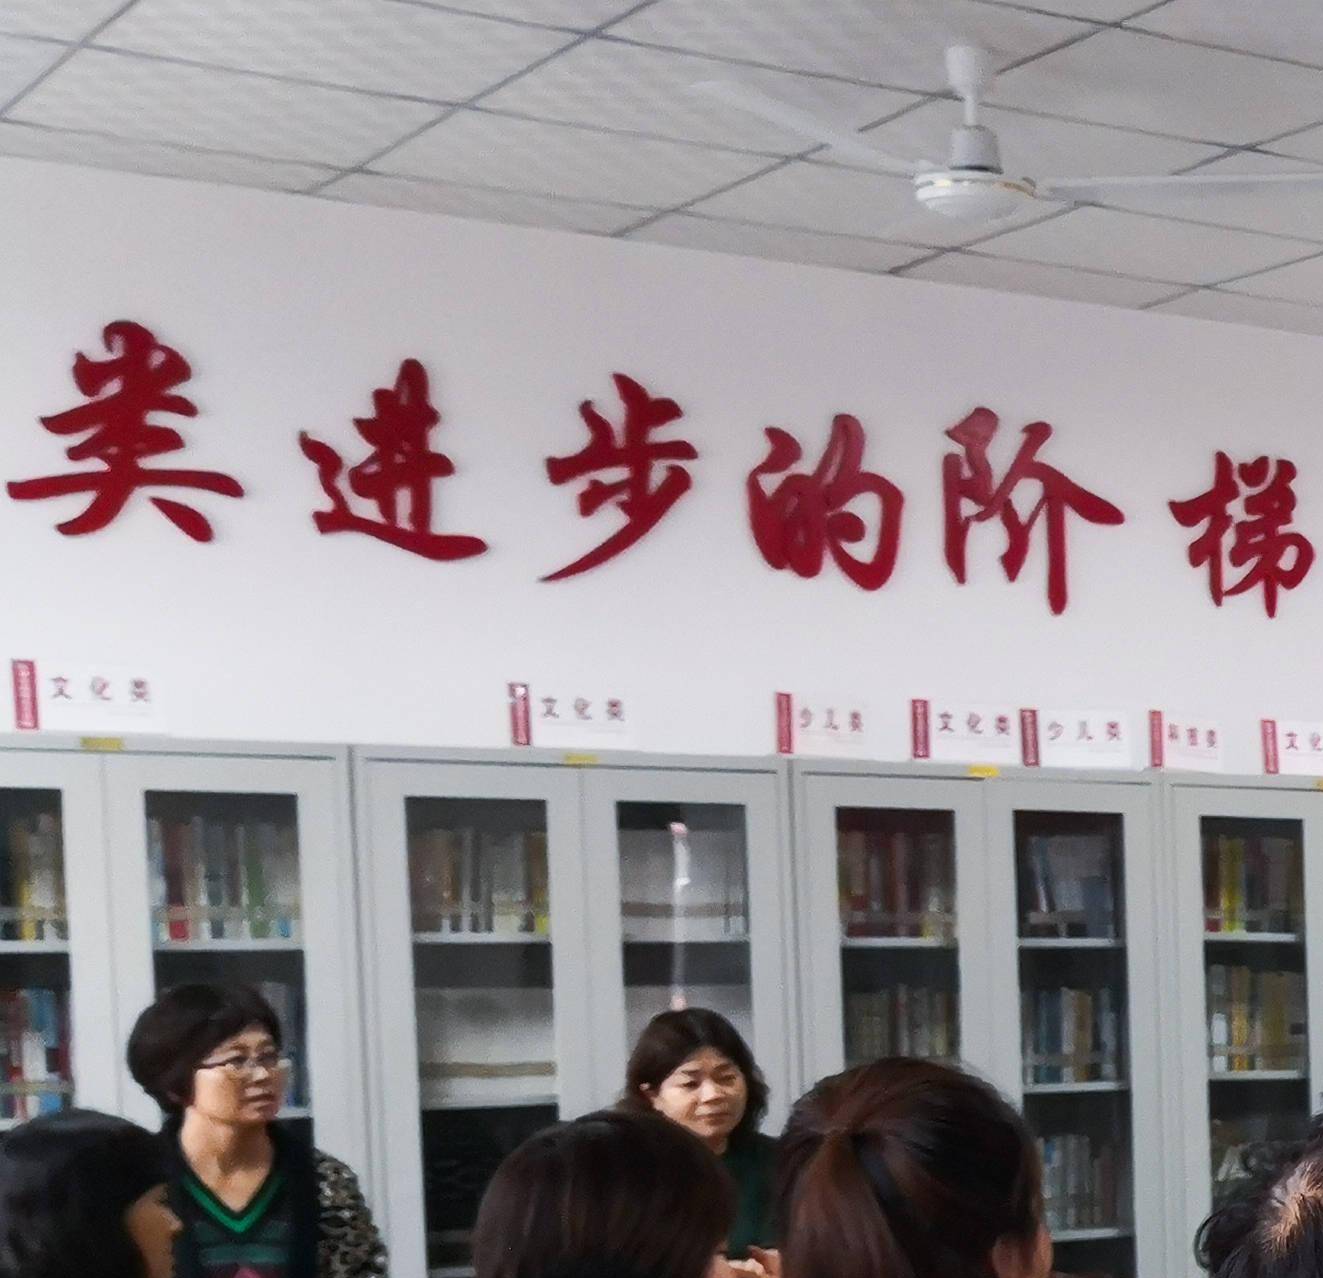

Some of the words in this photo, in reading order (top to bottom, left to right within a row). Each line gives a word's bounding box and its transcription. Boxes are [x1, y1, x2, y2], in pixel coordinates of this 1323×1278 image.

[6, 322, 1317, 619] 类进步的阶梯
[50, 676, 152, 702] 文化类
[541, 697, 624, 722] 文化类
[938, 711, 1010, 736] 文化类
